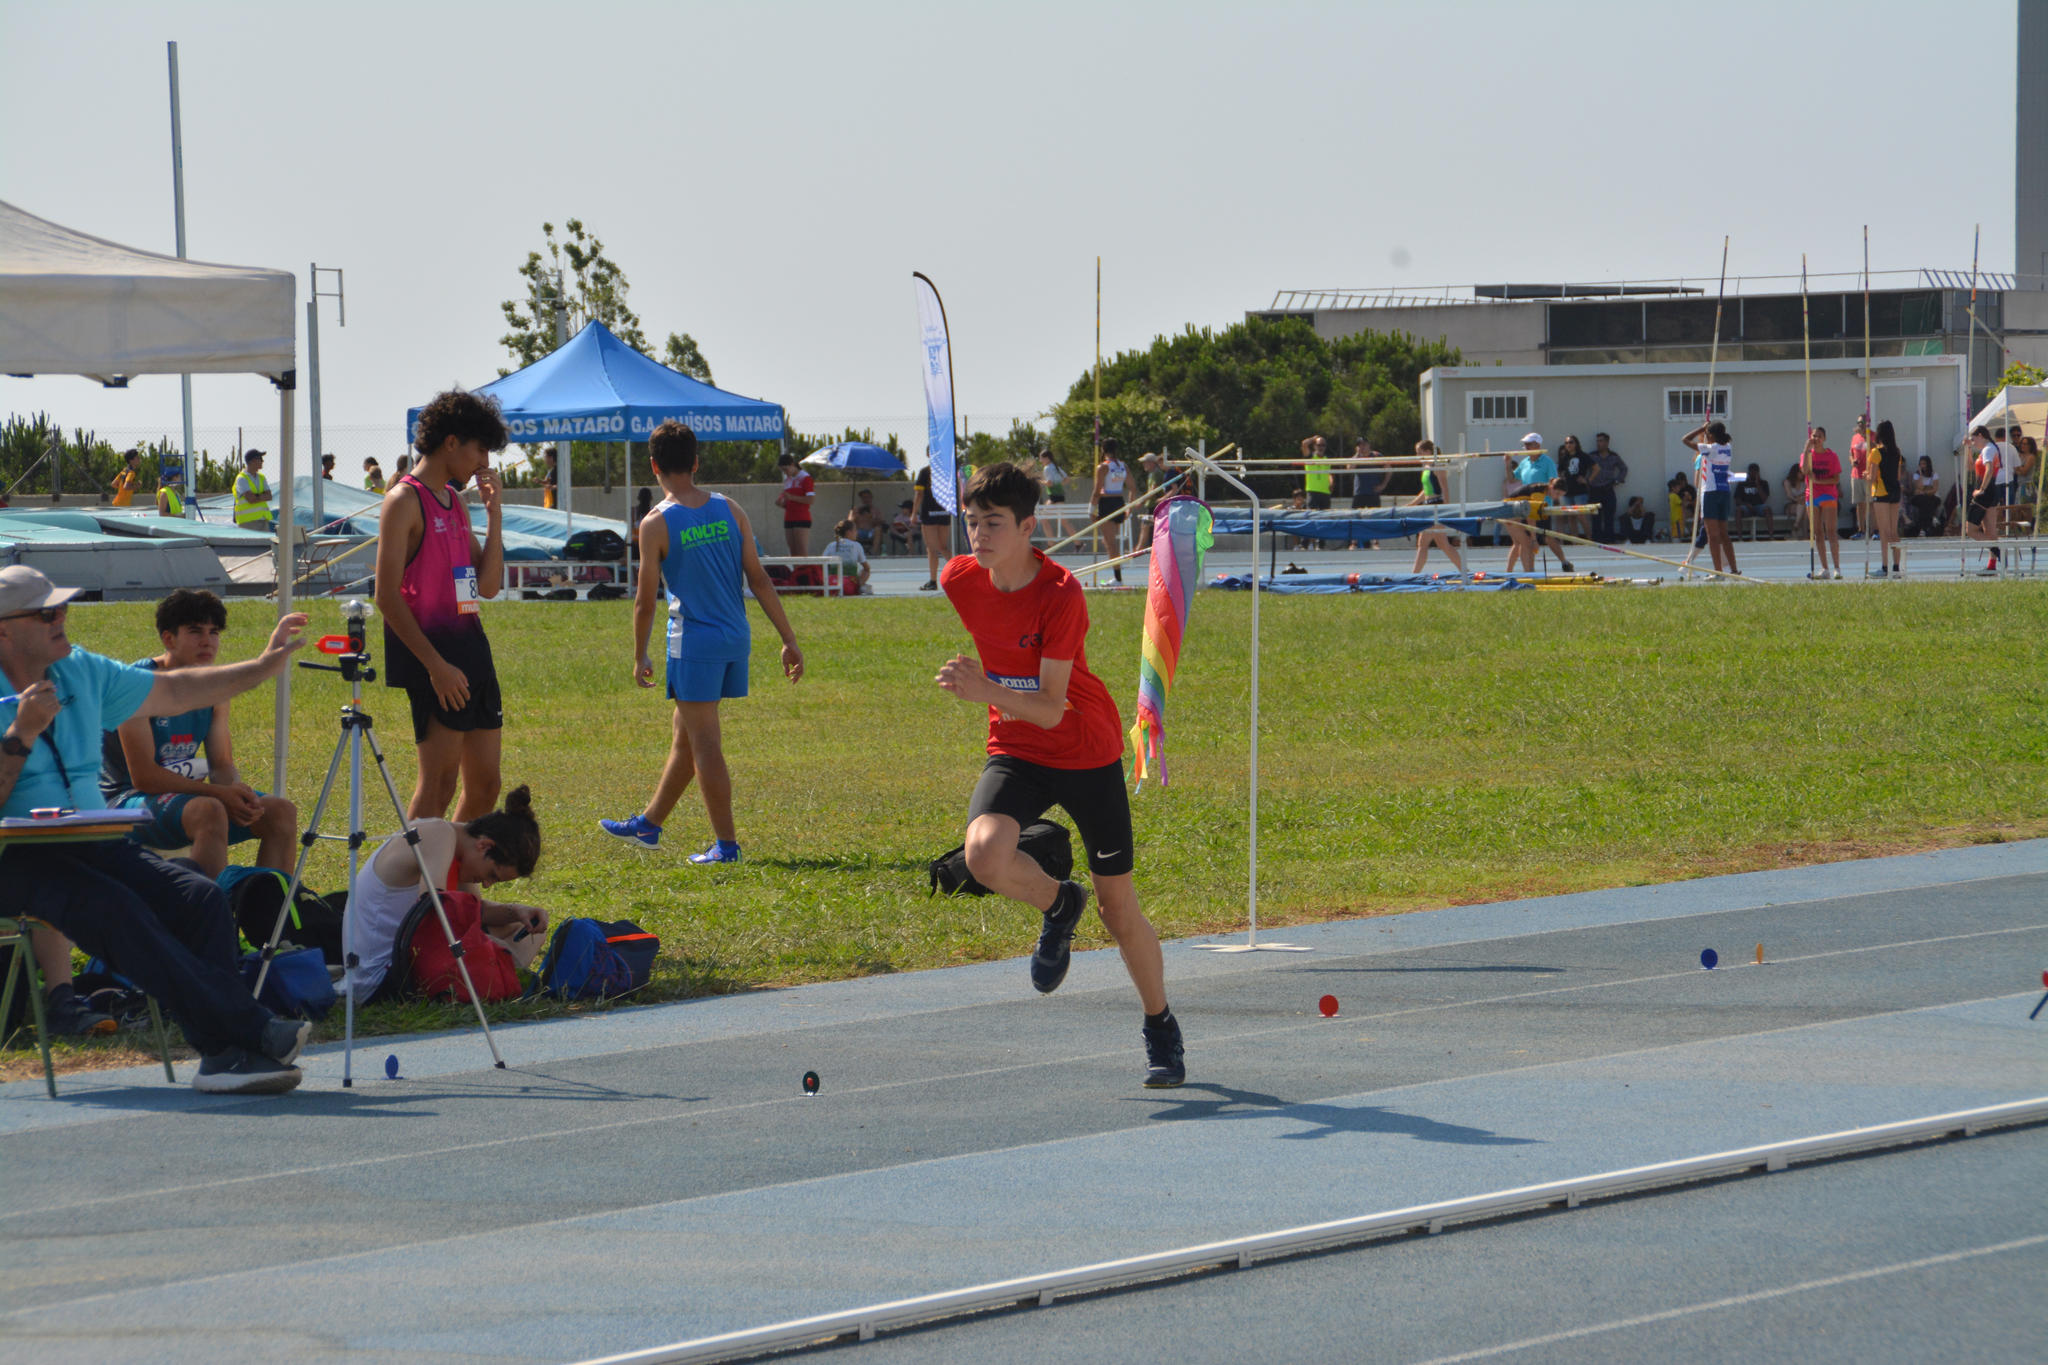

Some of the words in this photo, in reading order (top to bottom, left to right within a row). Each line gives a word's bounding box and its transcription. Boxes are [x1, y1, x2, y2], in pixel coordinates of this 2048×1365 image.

[543, 412, 624, 435] MATARÓ
[725, 411, 782, 432] MATARÓ
[680, 520, 728, 544] KNLTS
[999, 677, 1038, 689] Joma
